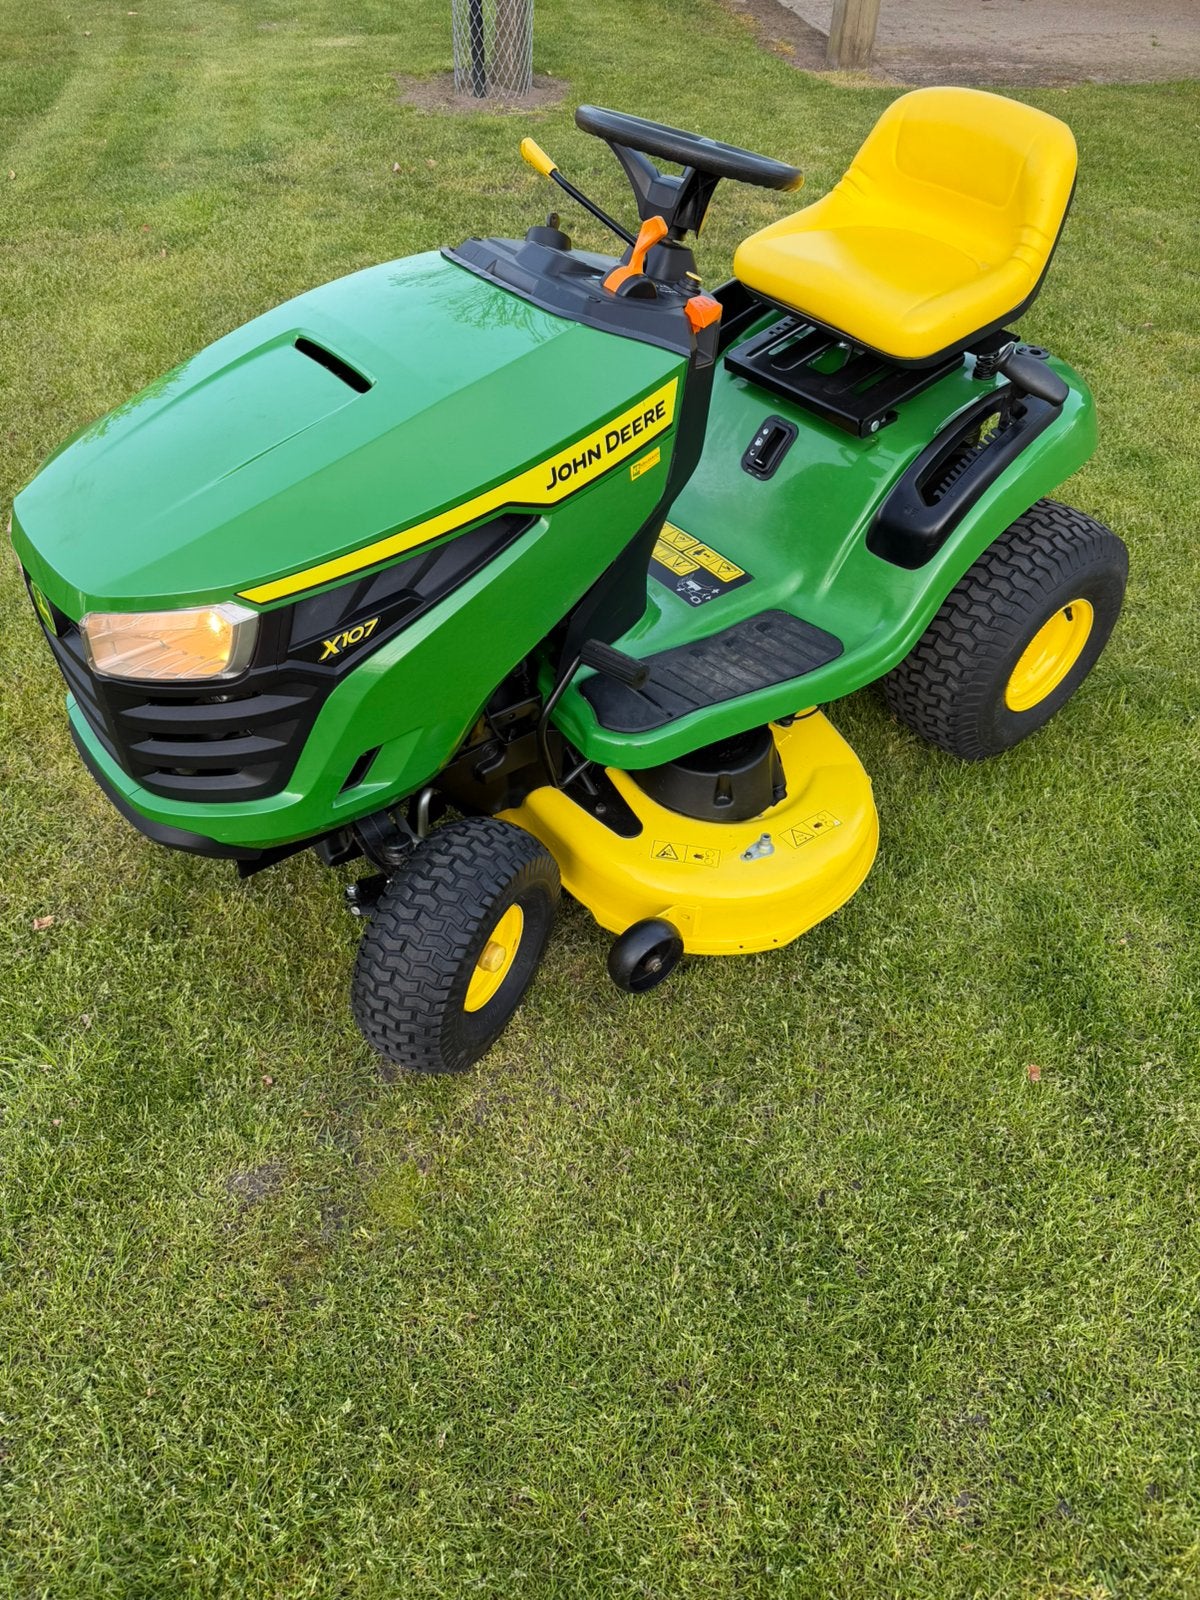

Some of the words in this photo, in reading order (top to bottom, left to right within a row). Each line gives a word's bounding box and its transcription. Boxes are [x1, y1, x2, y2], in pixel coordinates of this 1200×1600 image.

[546, 444, 601, 490] JOHN
[605, 400, 666, 454] DEERE
[319, 617, 379, 661] X107
